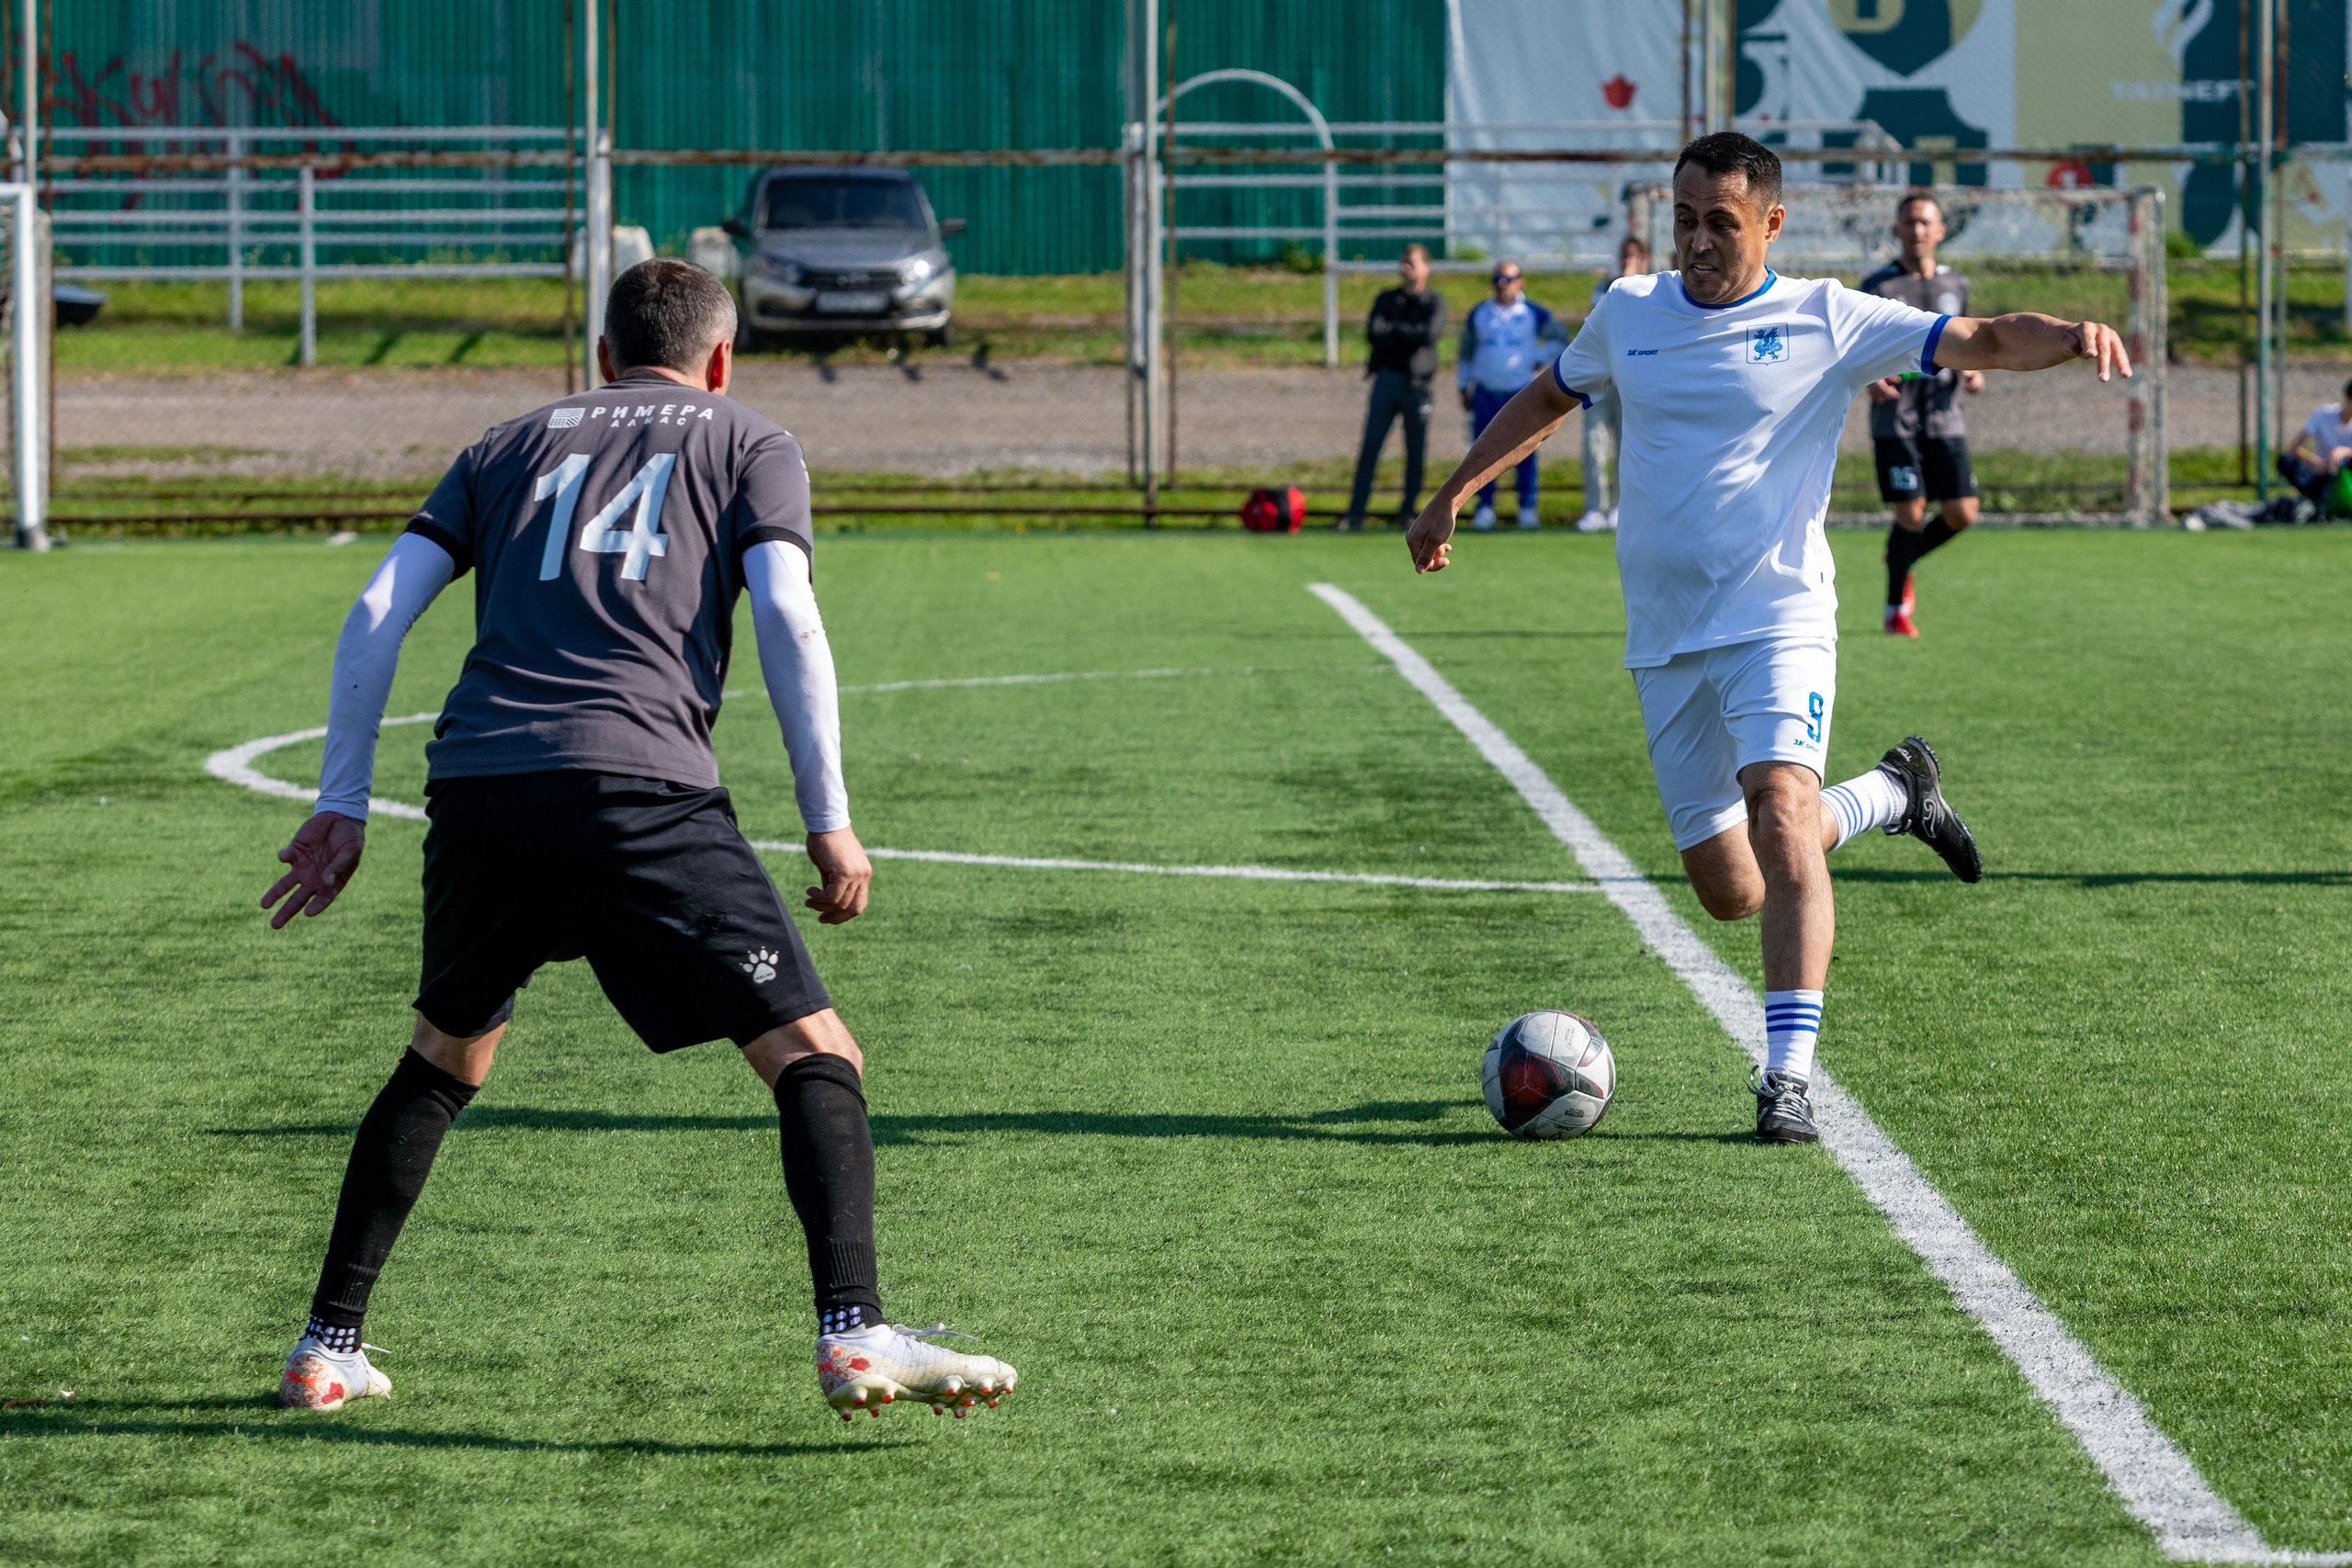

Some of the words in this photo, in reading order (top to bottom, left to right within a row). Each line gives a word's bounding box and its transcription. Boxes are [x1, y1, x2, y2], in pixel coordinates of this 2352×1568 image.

[591, 404, 715, 421] РИМЕРА
[534, 453, 677, 581] 14
[1807, 691, 1824, 744] 9
